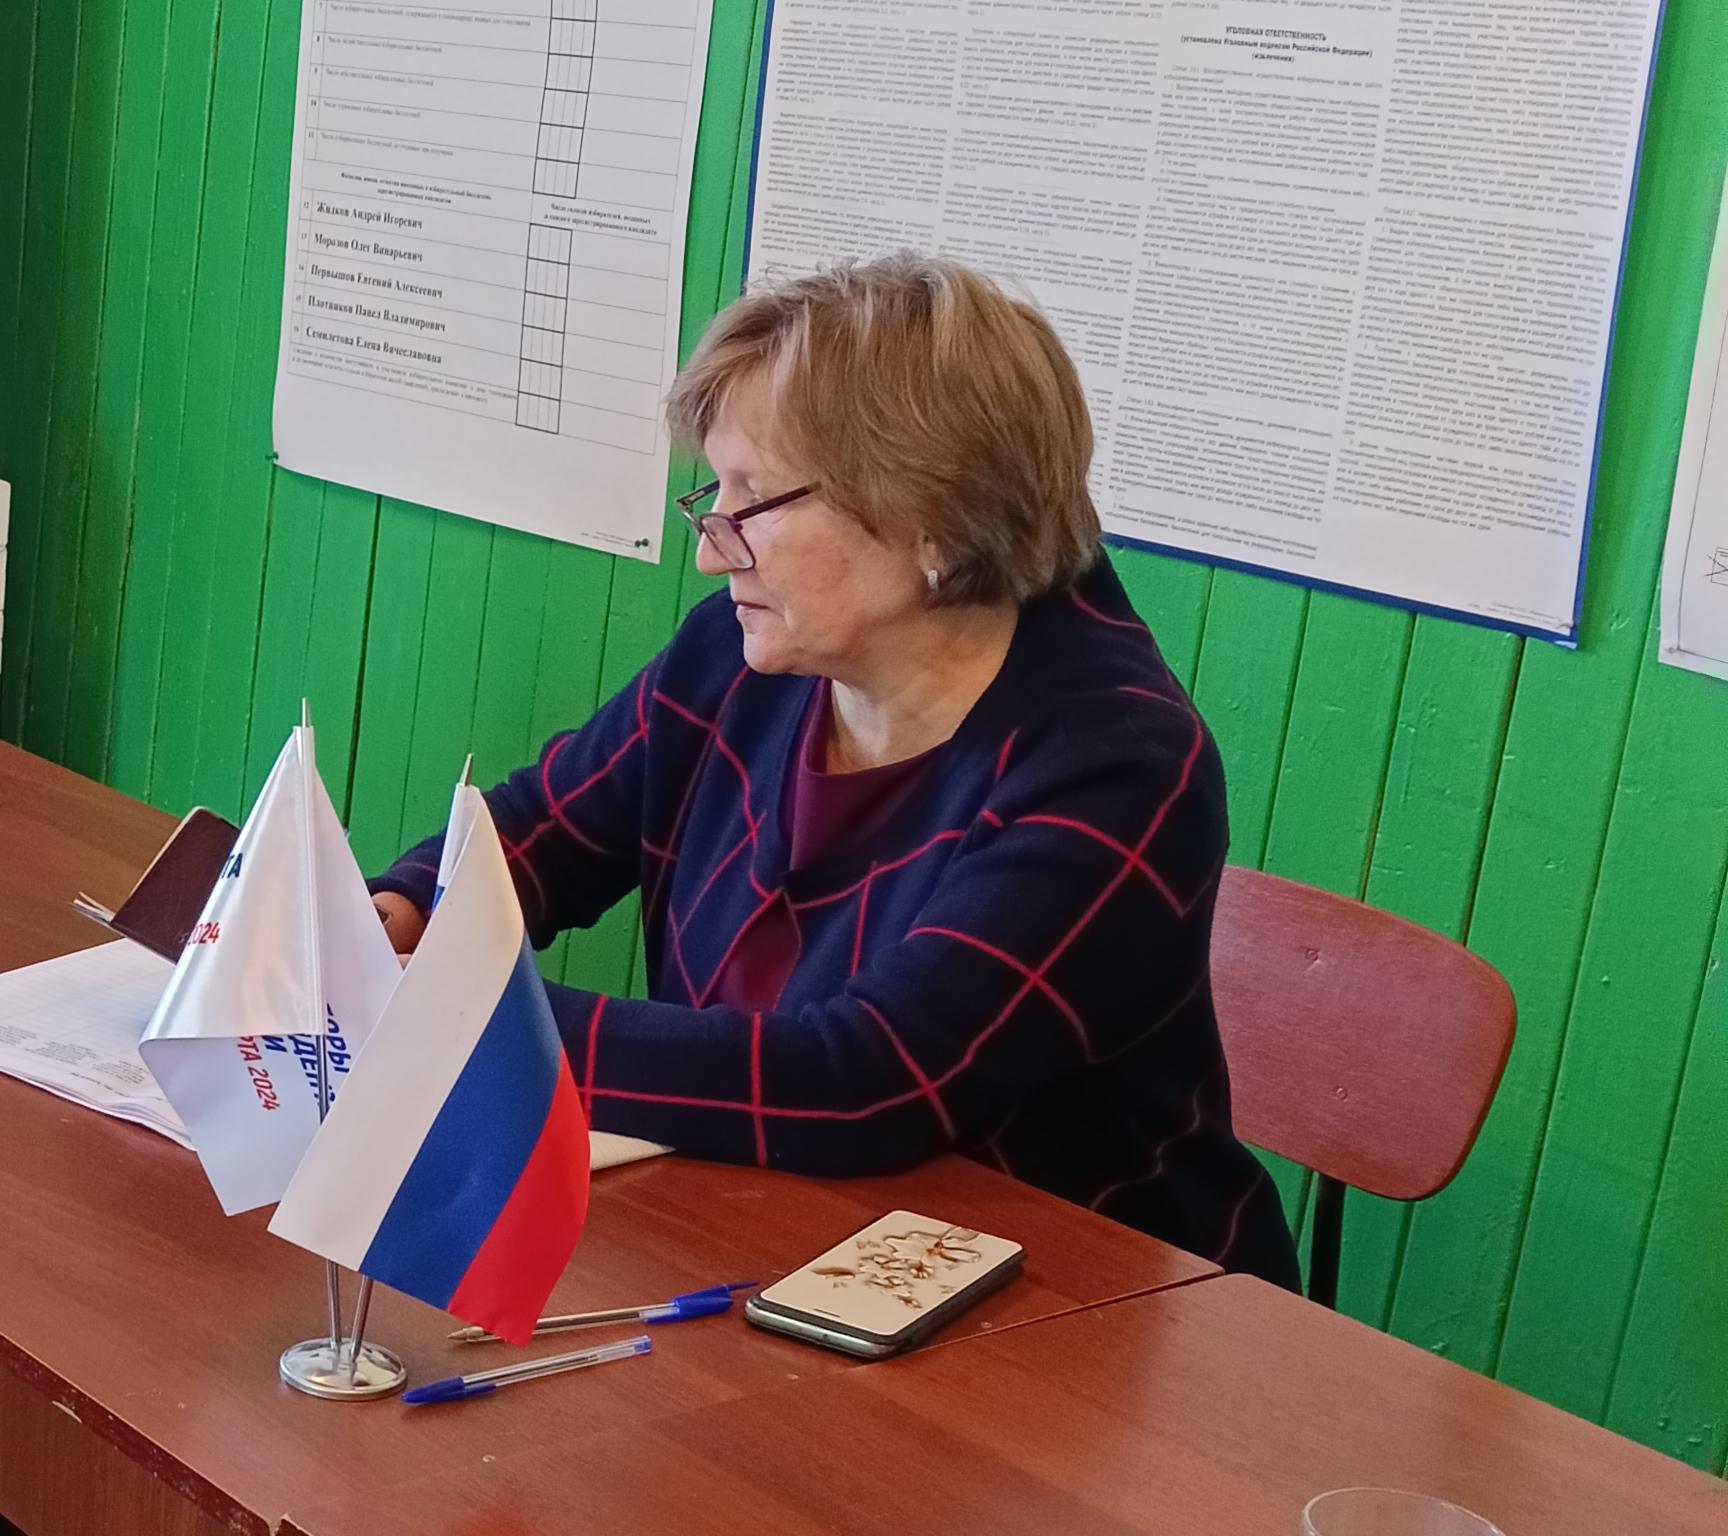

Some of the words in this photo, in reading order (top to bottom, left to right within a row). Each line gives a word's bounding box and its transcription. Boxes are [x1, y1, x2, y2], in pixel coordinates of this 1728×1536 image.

[1265, 28, 1327, 41] ОТВЕТСТВЕННОСТЬ
[383, 212, 422, 230] Игоревич
[351, 240, 371, 254] Олег
[357, 272, 392, 289] Евгений
[394, 280, 443, 299] Алексеевич
[355, 304, 381, 319] Павел
[383, 309, 445, 332] Владимирович
[356, 336, 381, 352] Елена
[383, 341, 442, 364] Вячеславовна
[247, 1066, 281, 1111] 2024
